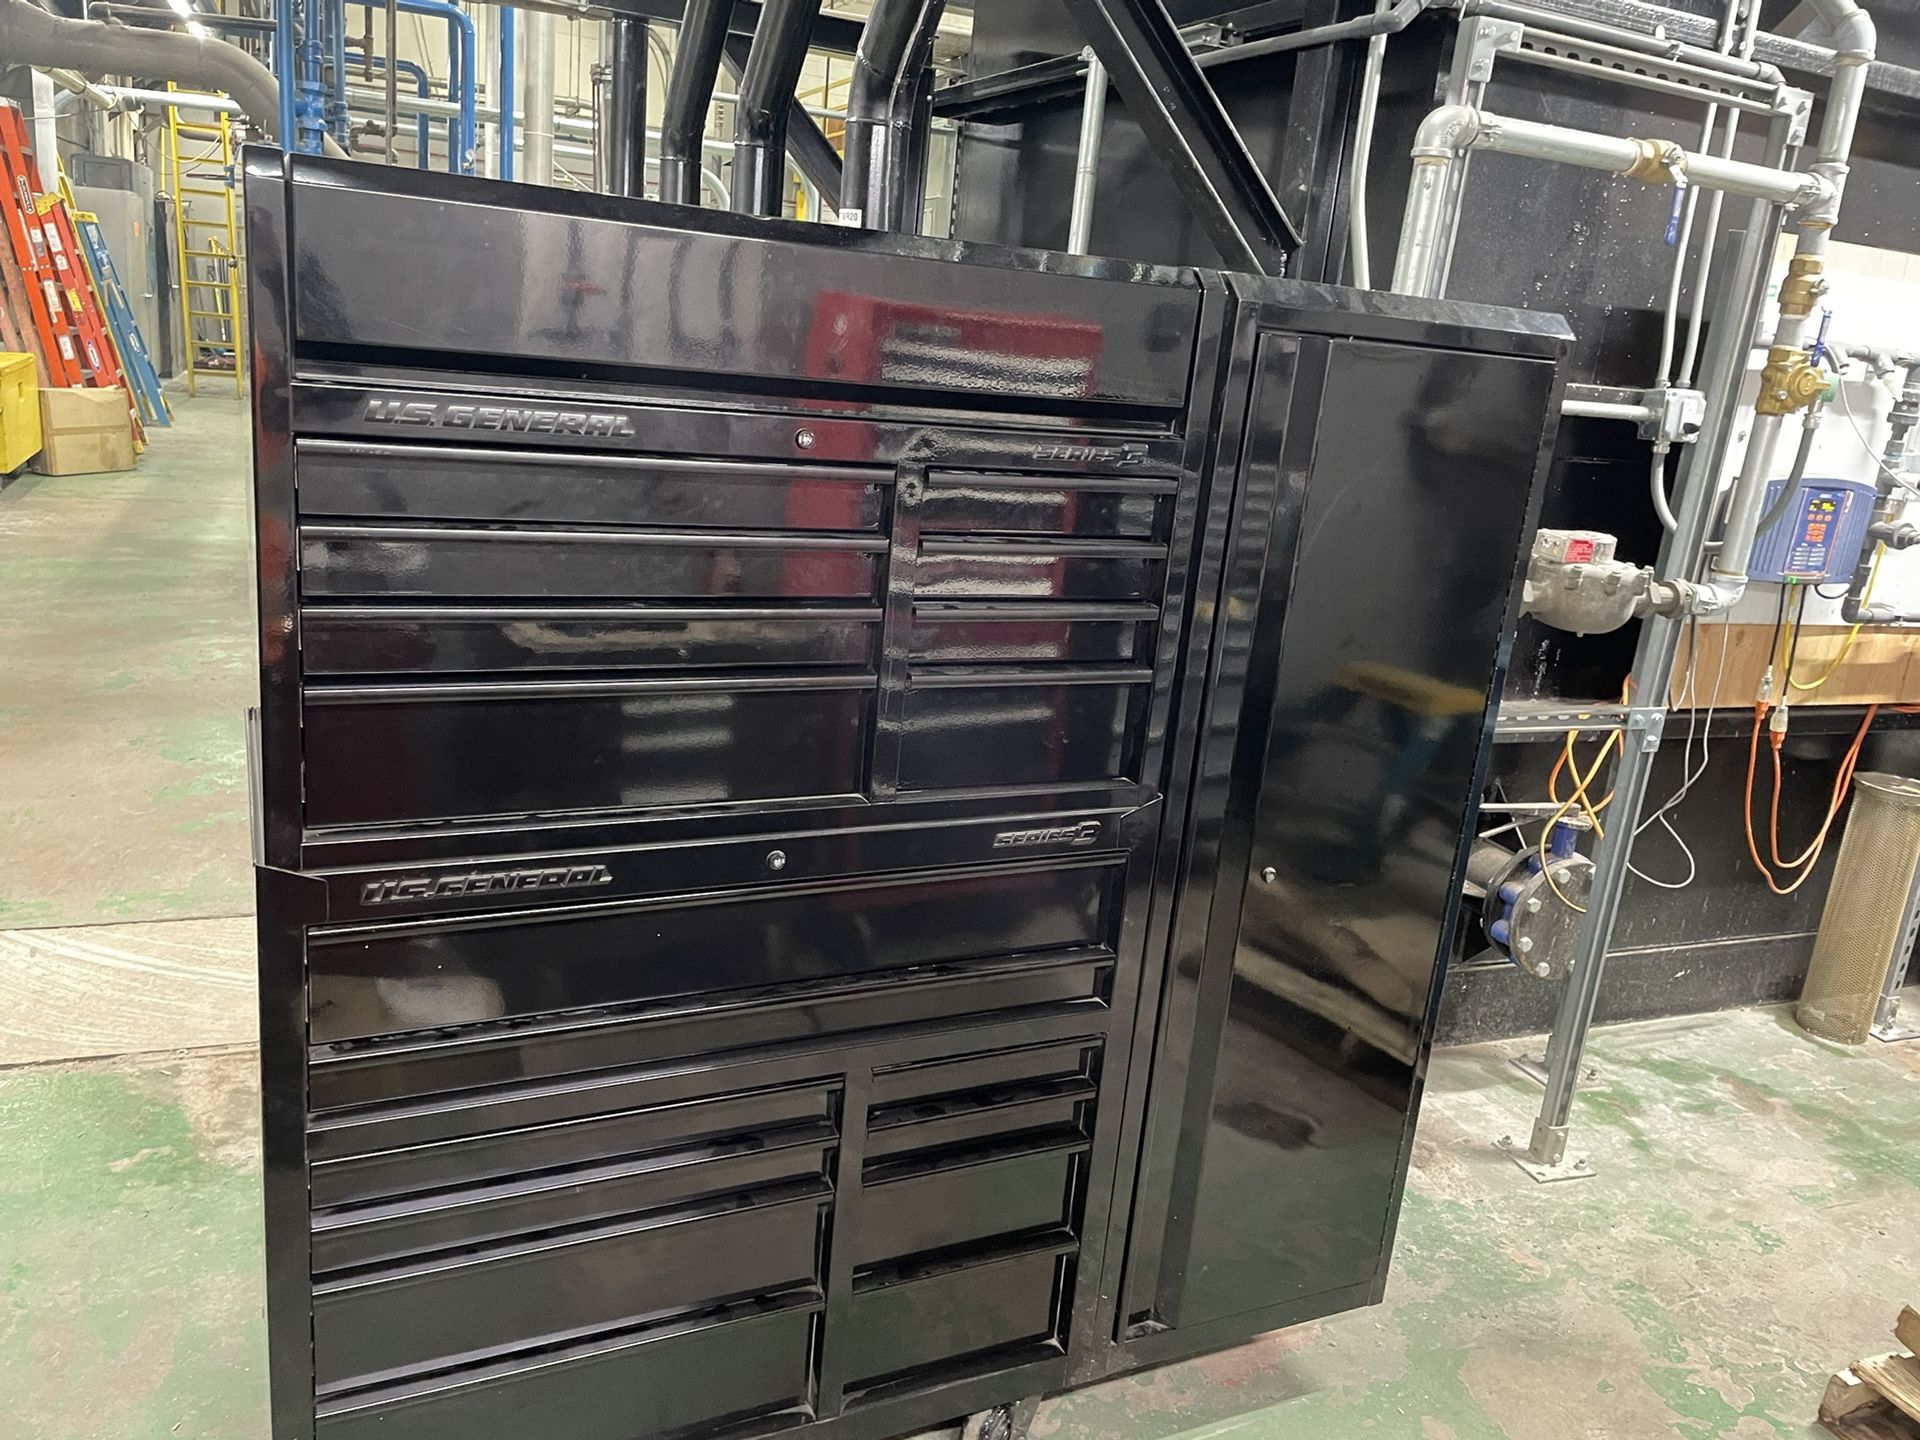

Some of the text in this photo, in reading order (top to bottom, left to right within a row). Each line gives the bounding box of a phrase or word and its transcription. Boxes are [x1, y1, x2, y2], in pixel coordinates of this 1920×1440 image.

[441, 405, 635, 437] GENERAL
[992, 827, 1079, 848] SERIES
[431, 865, 612, 898] GENERAL
